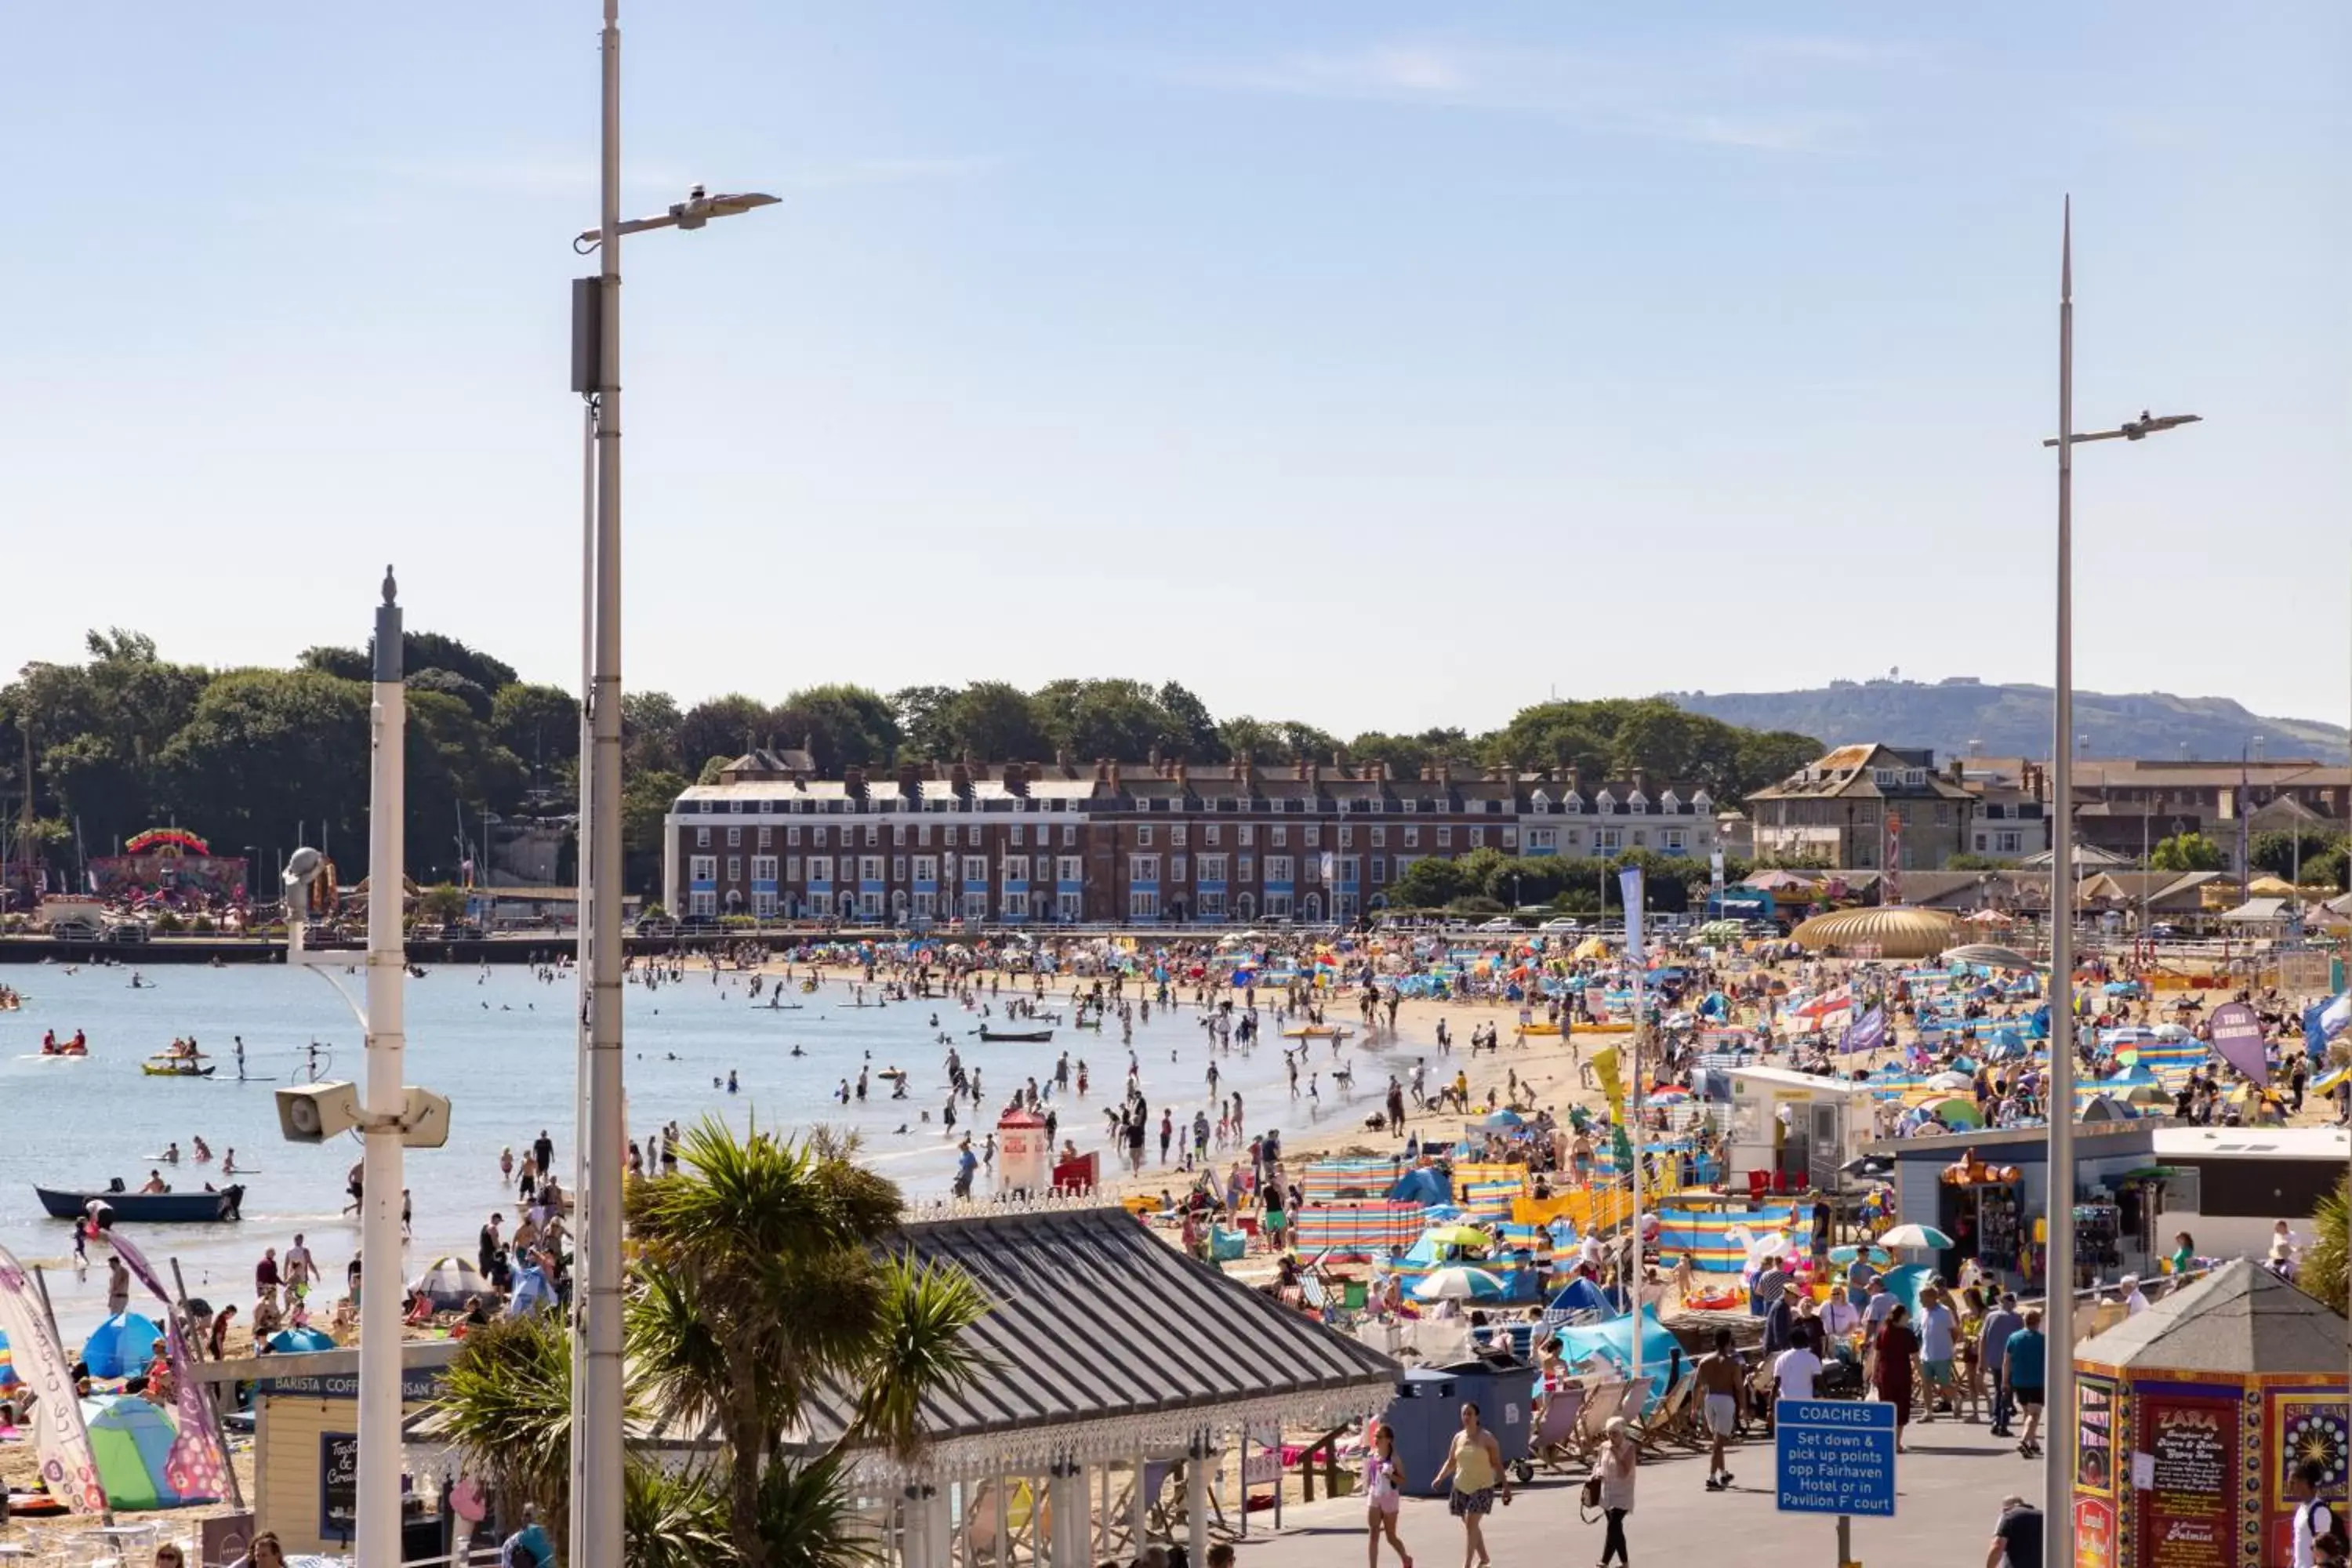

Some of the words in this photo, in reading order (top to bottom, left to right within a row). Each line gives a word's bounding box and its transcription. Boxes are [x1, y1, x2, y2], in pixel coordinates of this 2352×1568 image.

[274, 1377, 320, 1392] BARISTA
[325, 1378, 359, 1393] COFF
[1799, 1406, 1872, 1421] COACHES
[2158, 1409, 2220, 1431] ZARA
[2287, 1405, 2312, 1421] SHE
[1798, 1432, 1820, 1445] Set
[1824, 1434, 1860, 1446] down
[1864, 1436, 1874, 1446] &
[1788, 1449, 1816, 1461] pick
[1819, 1452, 1837, 1463] up
[1842, 1451, 1882, 1464] points
[1788, 1465, 1814, 1477] opp
[1819, 1464, 1882, 1478] Fairhaven
[1800, 1479, 1838, 1492] Hotel
[1842, 1482, 1855, 1493] or
[1859, 1481, 1871, 1494] in
[1783, 1493, 1835, 1507] Pavilion
[1854, 1497, 1889, 1510] court
